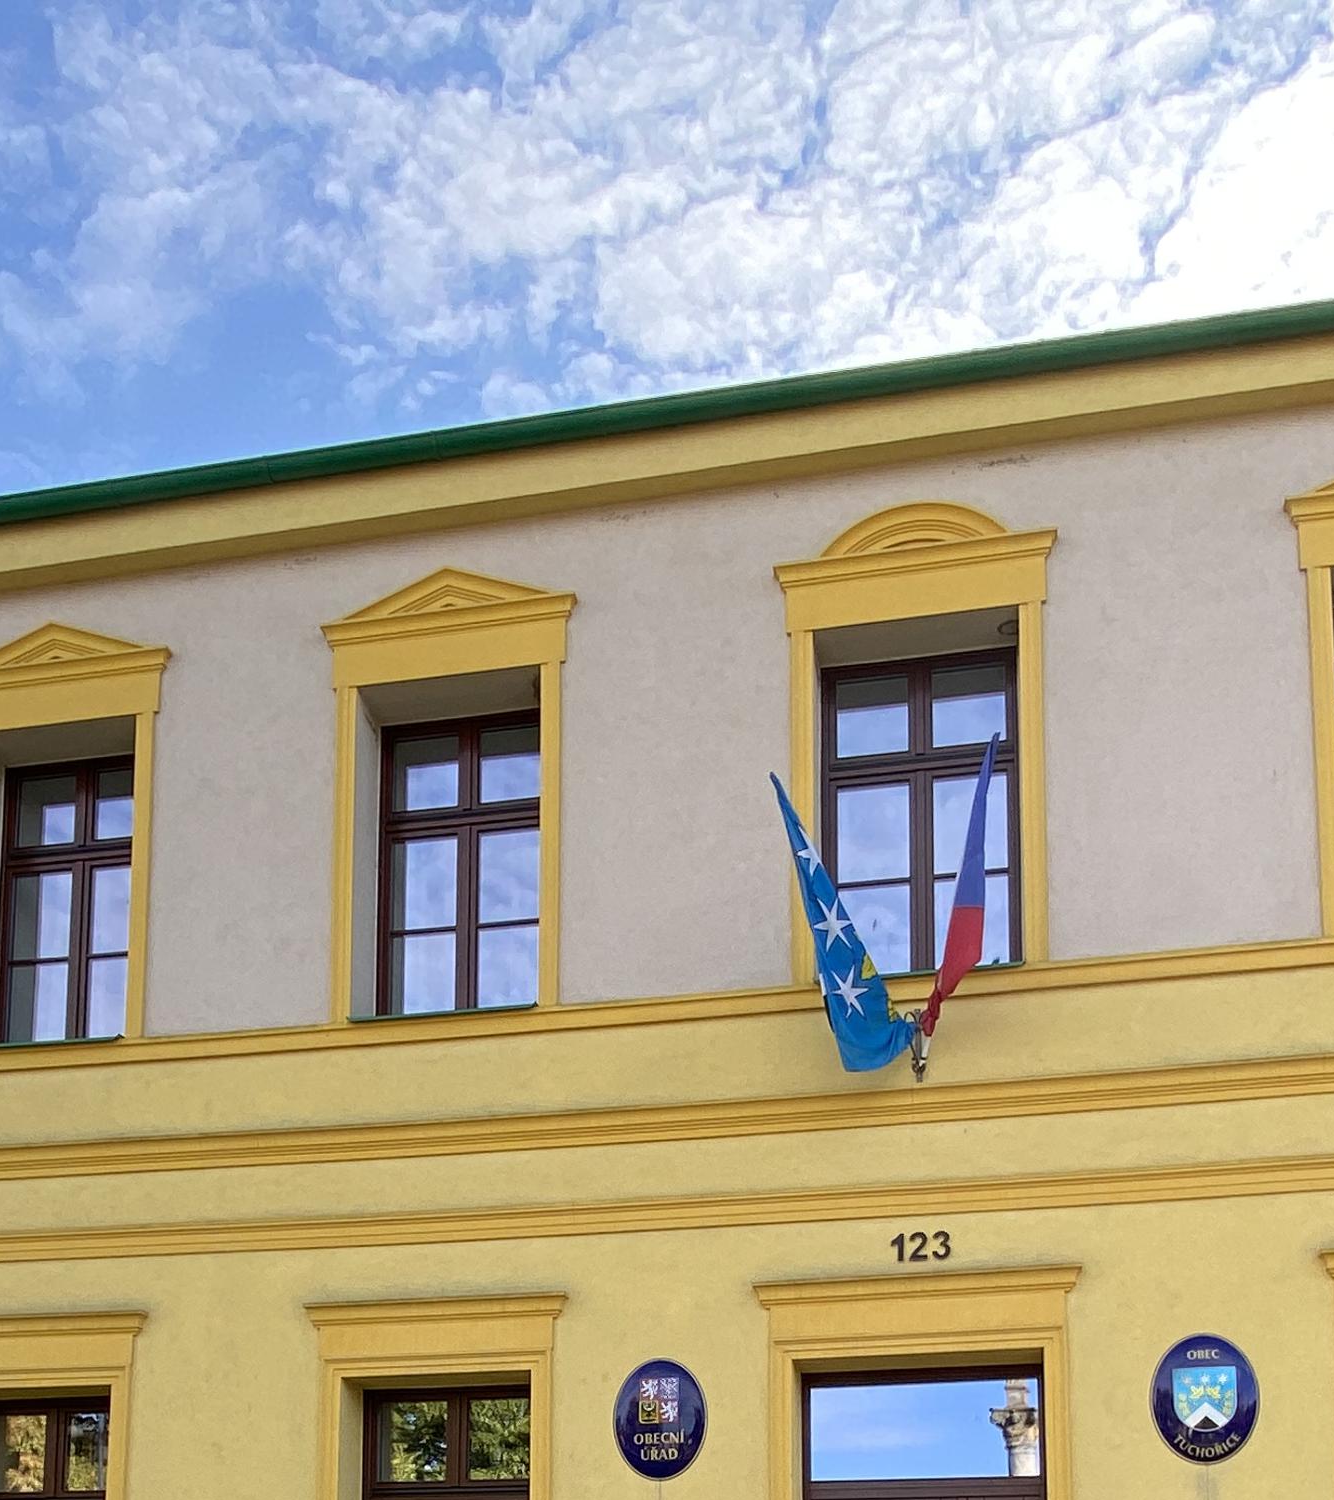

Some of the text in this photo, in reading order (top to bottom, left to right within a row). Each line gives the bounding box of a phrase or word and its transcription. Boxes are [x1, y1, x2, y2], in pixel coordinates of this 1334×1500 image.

[891, 1230, 951, 1262] 123
[1186, 1349, 1220, 1360] OBEC
[633, 1428, 684, 1445] OBECNÍ
[1173, 1432, 1241, 1458] TUCHOŘICE
[640, 1446, 678, 1461] ÚŘAD
